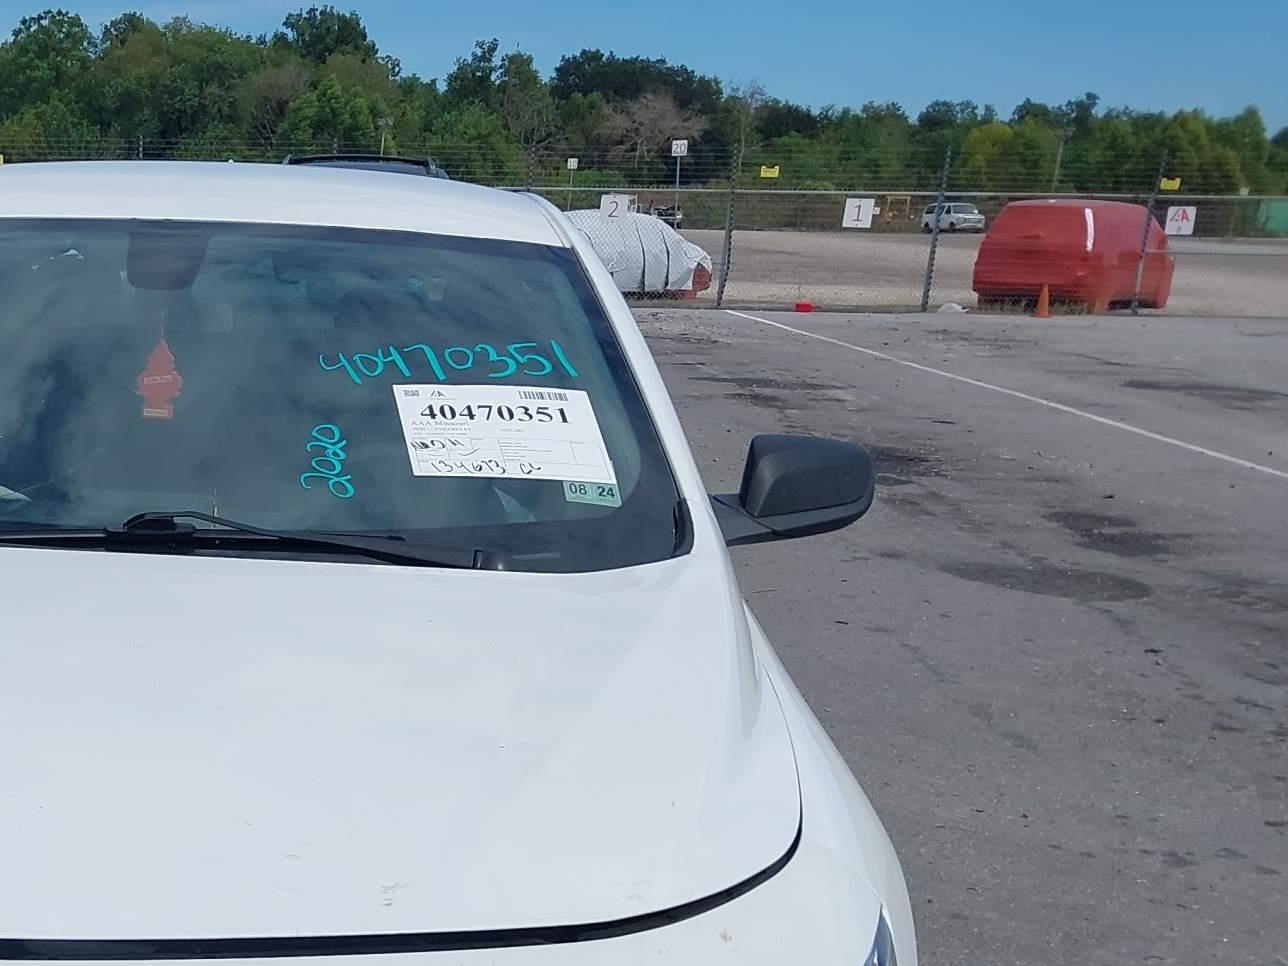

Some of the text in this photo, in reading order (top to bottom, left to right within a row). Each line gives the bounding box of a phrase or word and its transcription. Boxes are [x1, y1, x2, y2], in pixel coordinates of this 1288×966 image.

[672, 142, 687, 155] 20
[607, 200, 619, 218] 2
[852, 204, 863, 222] 1
[318, 339, 579, 385] 40470351
[420, 403, 570, 424] 40470351
[300, 423, 356, 499] 2020
[568, 482, 616, 499] 08 24
